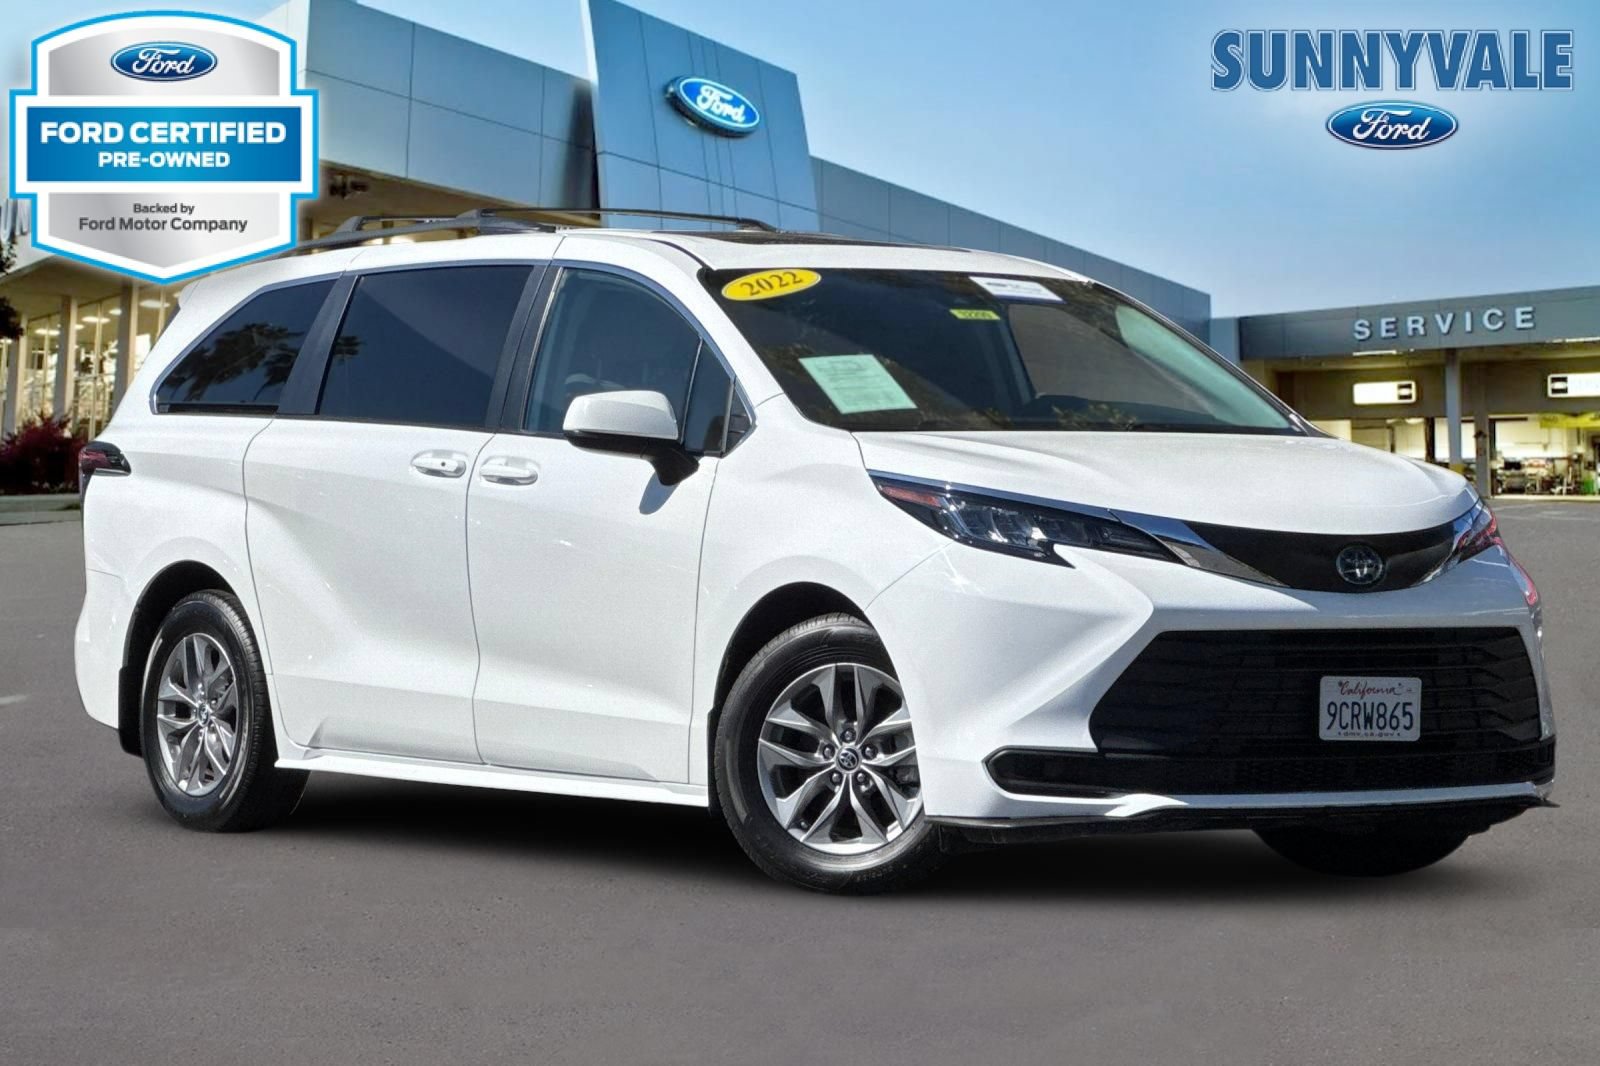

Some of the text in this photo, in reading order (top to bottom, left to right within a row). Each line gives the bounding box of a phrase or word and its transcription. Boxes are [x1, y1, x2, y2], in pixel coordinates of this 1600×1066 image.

[696, 84, 746, 122] Ford
[740, 271, 803, 296] 2022
[1353, 306, 1536, 341] SERVICE
[1340, 680, 1402, 700] California
[1327, 701, 1414, 731] 9CRW865
